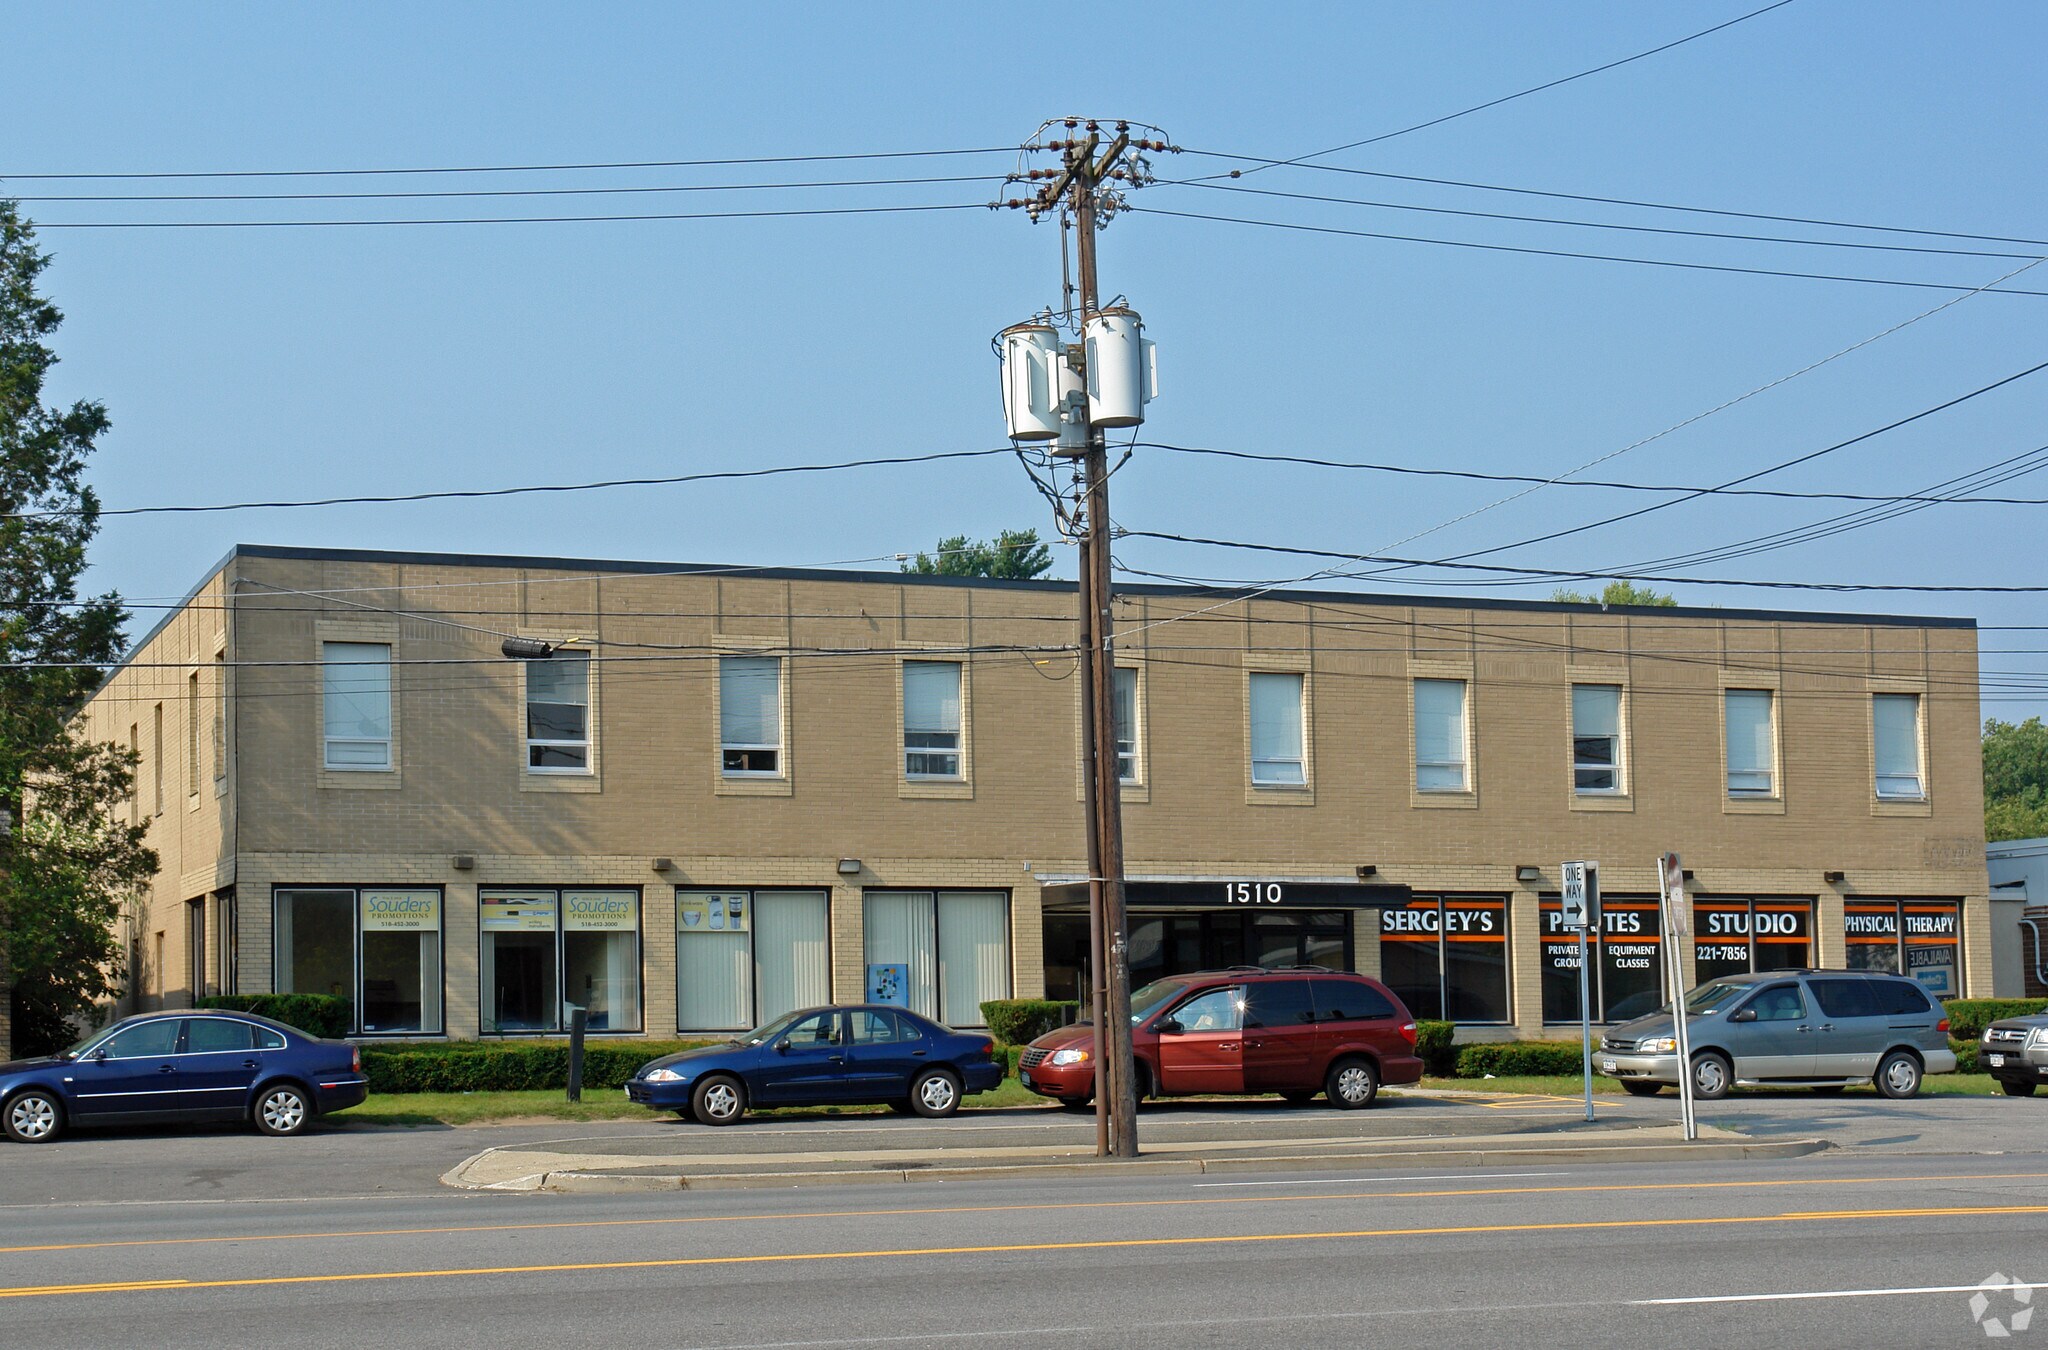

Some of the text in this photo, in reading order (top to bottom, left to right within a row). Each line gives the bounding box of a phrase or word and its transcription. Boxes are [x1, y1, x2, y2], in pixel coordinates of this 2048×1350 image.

[1565, 867, 1582, 882] ONE
[1226, 883, 1282, 903] 1510
[1565, 884, 1583, 899] WAY
[368, 896, 432, 912] Souders
[569, 897, 629, 912] Souders
[1382, 910, 1493, 932] SERGEY'S
[1550, 912, 1798, 934] PTES STUDIO
[1845, 916, 1954, 933] PHYSICAL THERAPY
[1548, 945, 1579, 955] PRIVATE
[1608, 945, 1656, 955] EQUIPMENT
[1697, 946, 1747, 960] 221-7856
[1616, 958, 1650, 968] CLASSES
